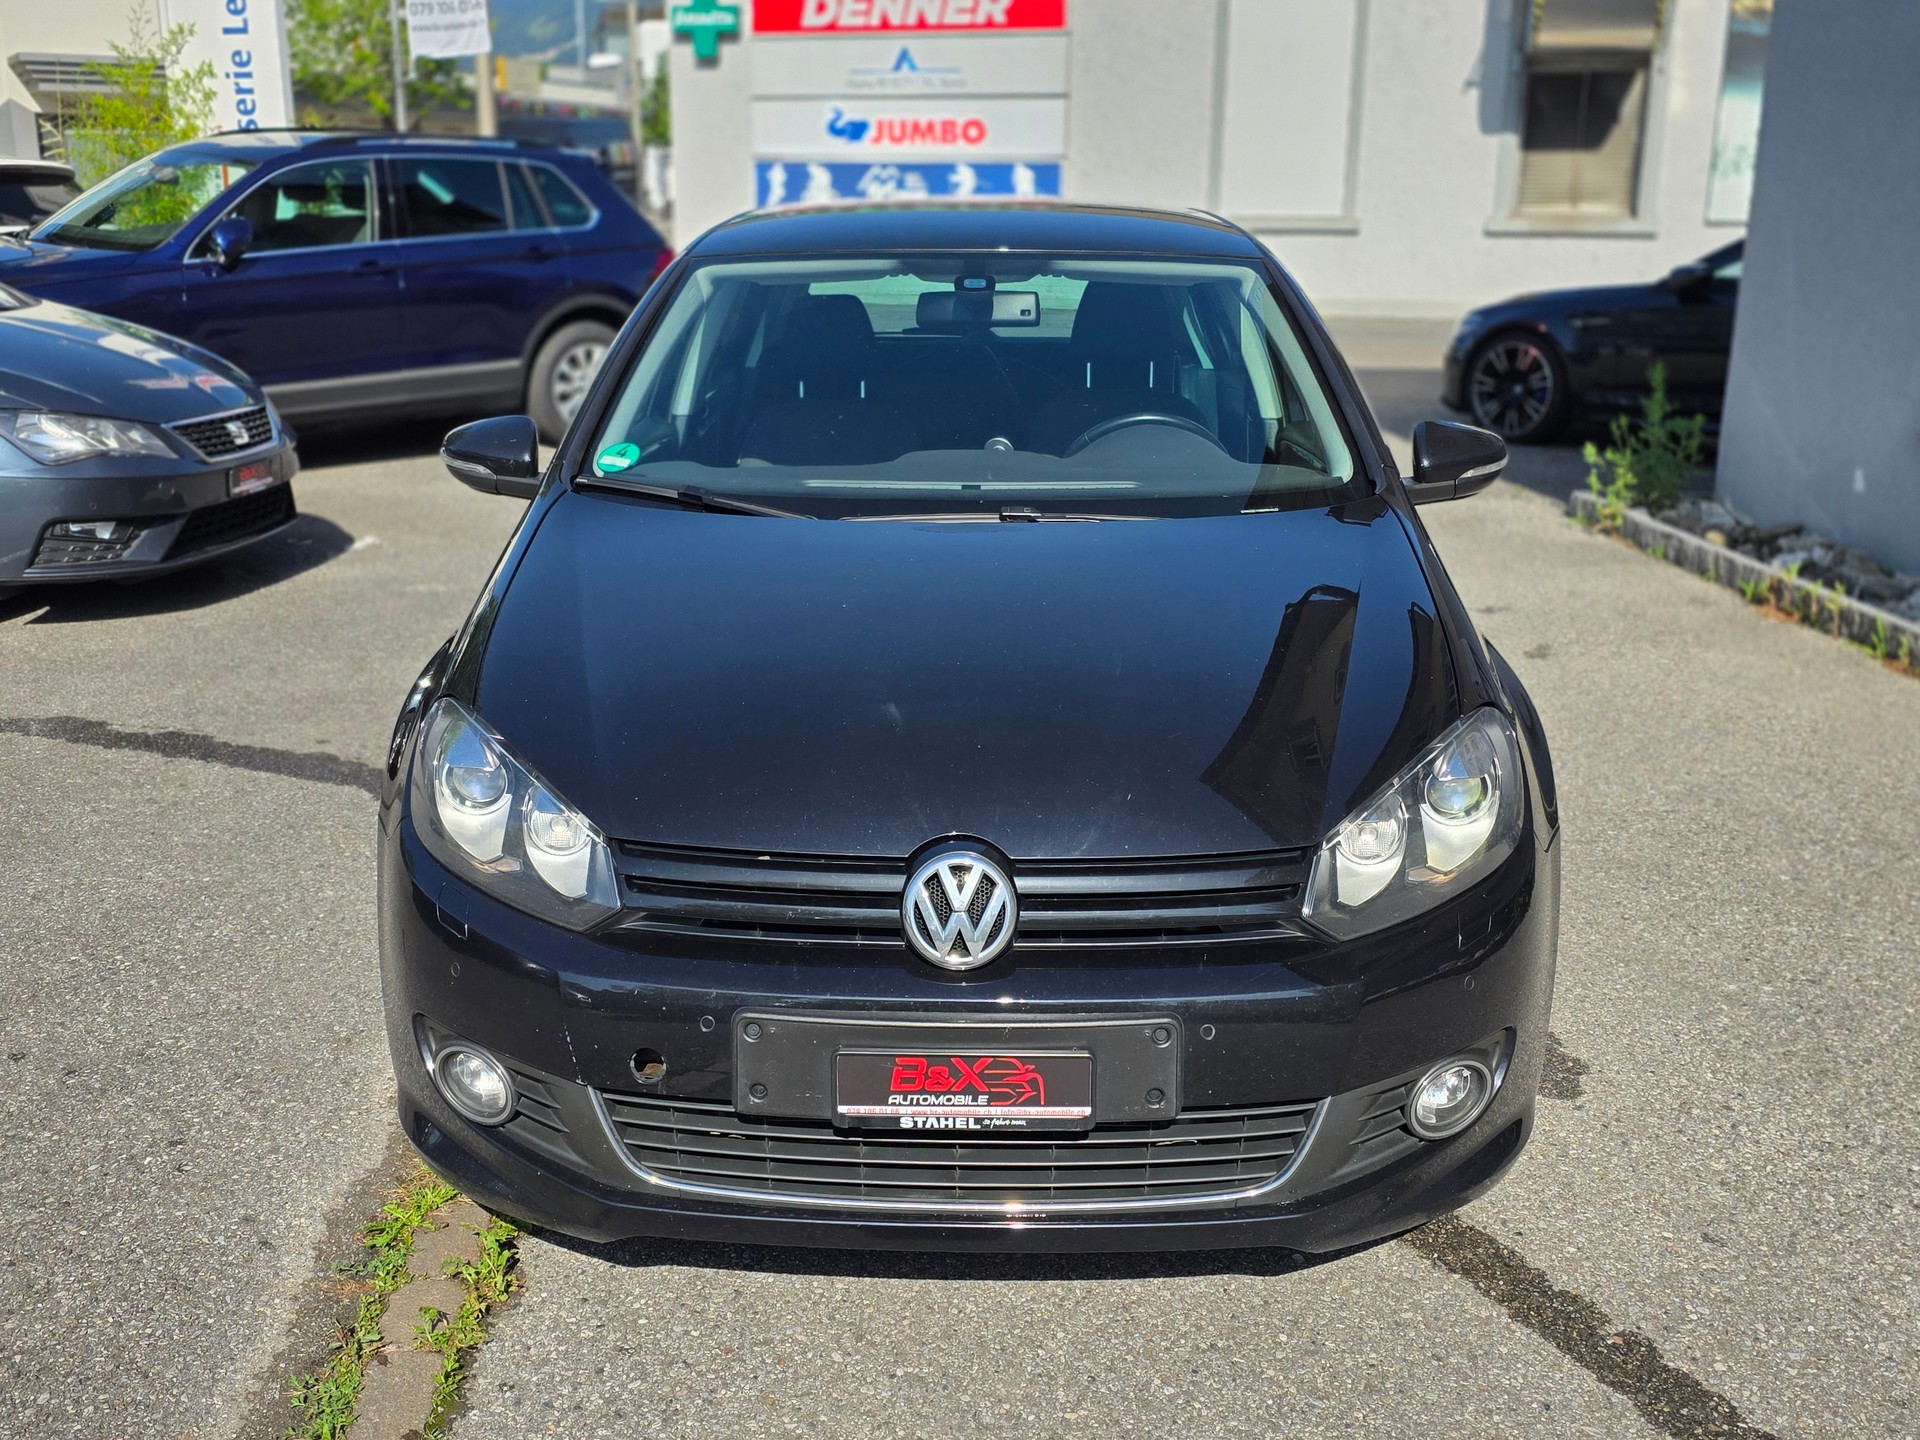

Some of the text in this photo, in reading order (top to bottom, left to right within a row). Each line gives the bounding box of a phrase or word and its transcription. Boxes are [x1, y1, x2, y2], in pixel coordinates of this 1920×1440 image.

[801, 0, 1012, 28] DENNER
[870, 119, 987, 145] JUMBO
[615, 444, 631, 458] 4
[890, 1057, 994, 1092] B&X
[887, 1094, 989, 1106] AUTOMOBILE
[899, 1117, 981, 1129] STAHEL
